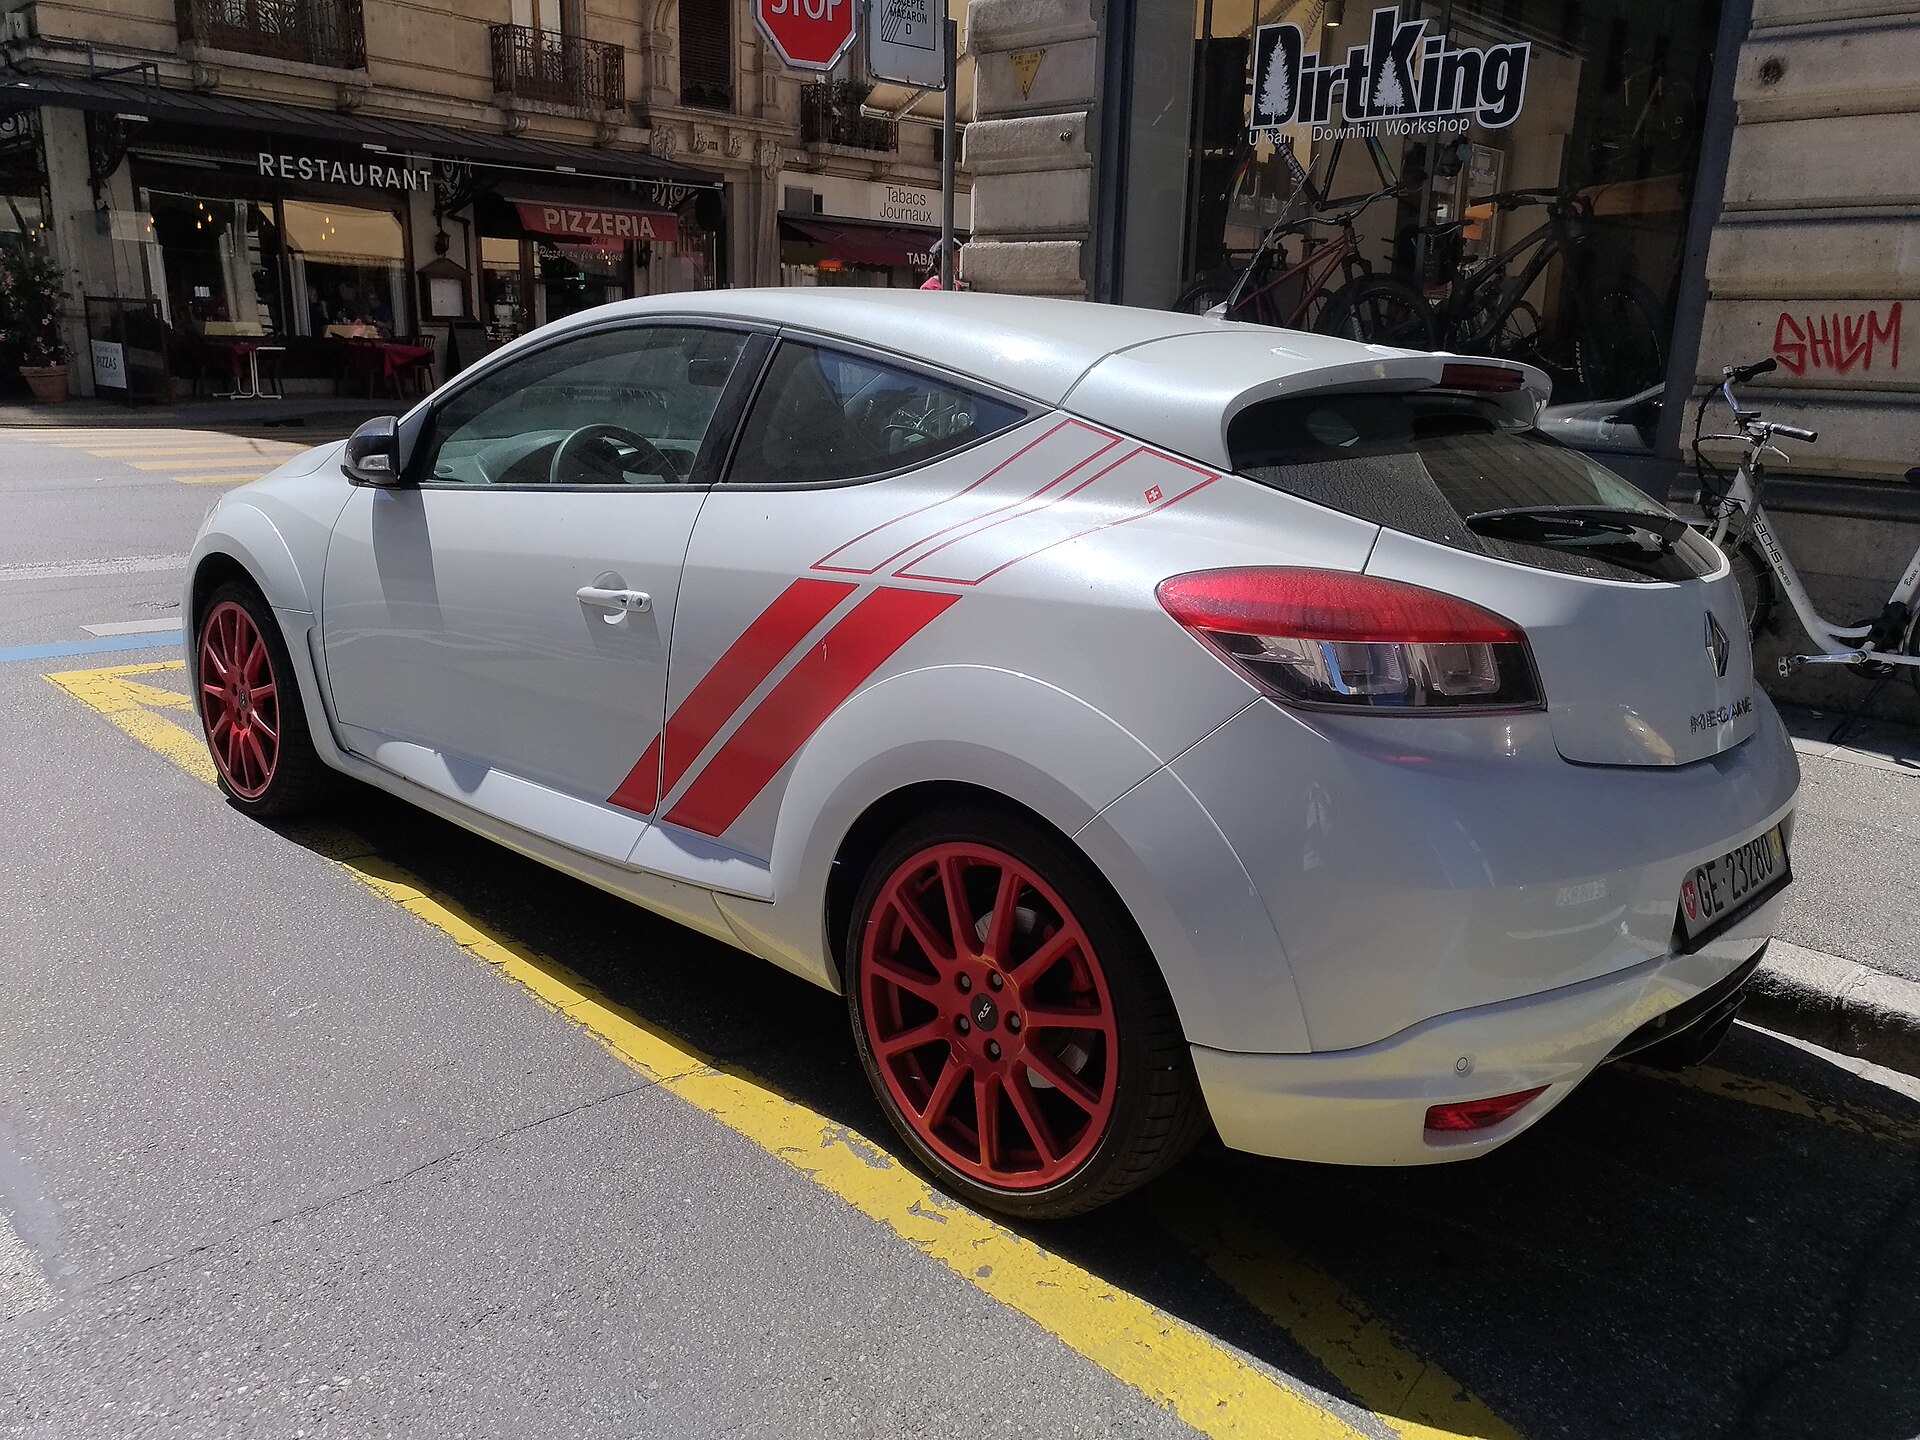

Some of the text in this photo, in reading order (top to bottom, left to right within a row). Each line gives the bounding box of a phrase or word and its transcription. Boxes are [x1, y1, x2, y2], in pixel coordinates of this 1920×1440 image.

[889, 6, 928, 24] MACARON
[905, 22, 912, 35] D
[1250, 5, 1531, 129] DirtKing
[1249, 129, 1291, 146] Urban
[1313, 121, 1379, 142] Downhill
[1385, 117, 1470, 136] Workshop
[258, 152, 432, 192] RESTAURANT
[885, 186, 926, 206] Tabacs
[543, 208, 656, 238] PIZZERIA
[879, 202, 932, 223] Journaux
[1690, 696, 1753, 734] MEGANE
